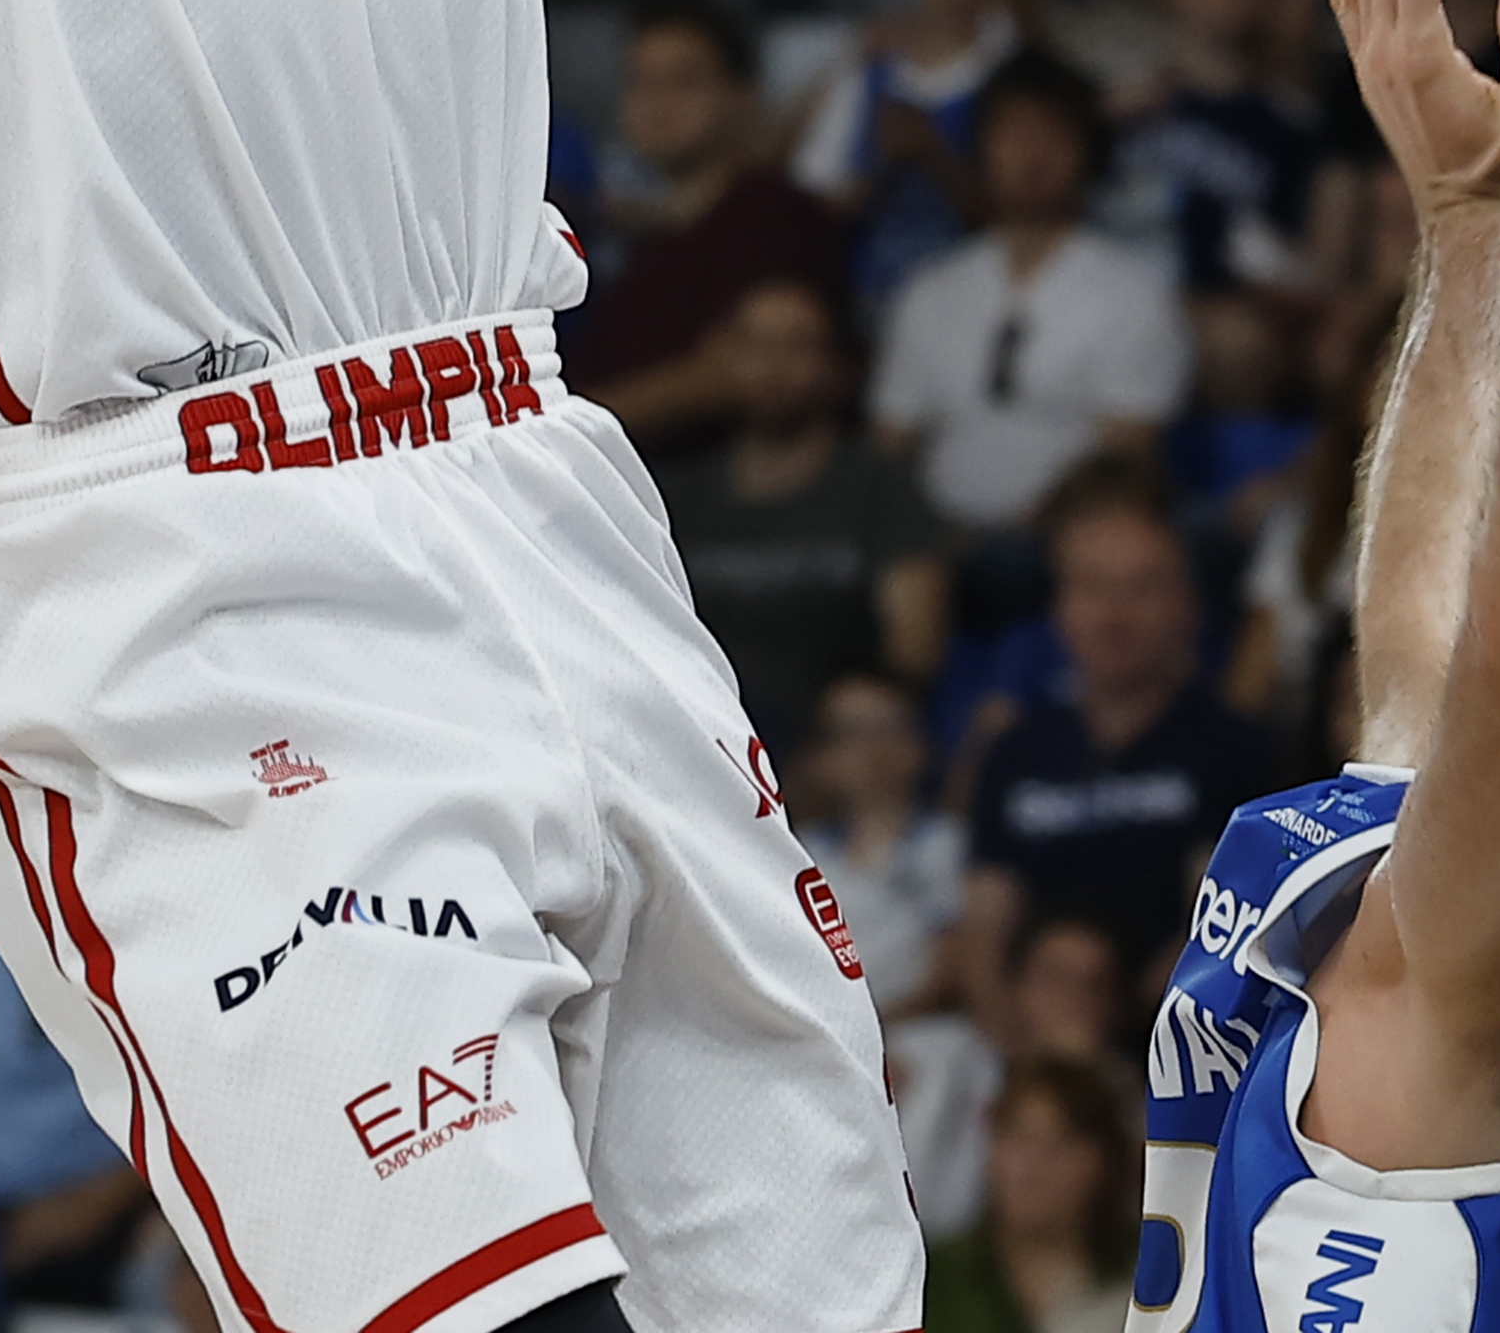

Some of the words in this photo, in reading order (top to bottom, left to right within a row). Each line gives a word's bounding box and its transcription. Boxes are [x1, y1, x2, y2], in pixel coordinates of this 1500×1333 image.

[178, 324, 545, 475] OLIMPIA
[344, 1033, 500, 1160] EA7
[374, 1124, 455, 1181] EMPORIO
